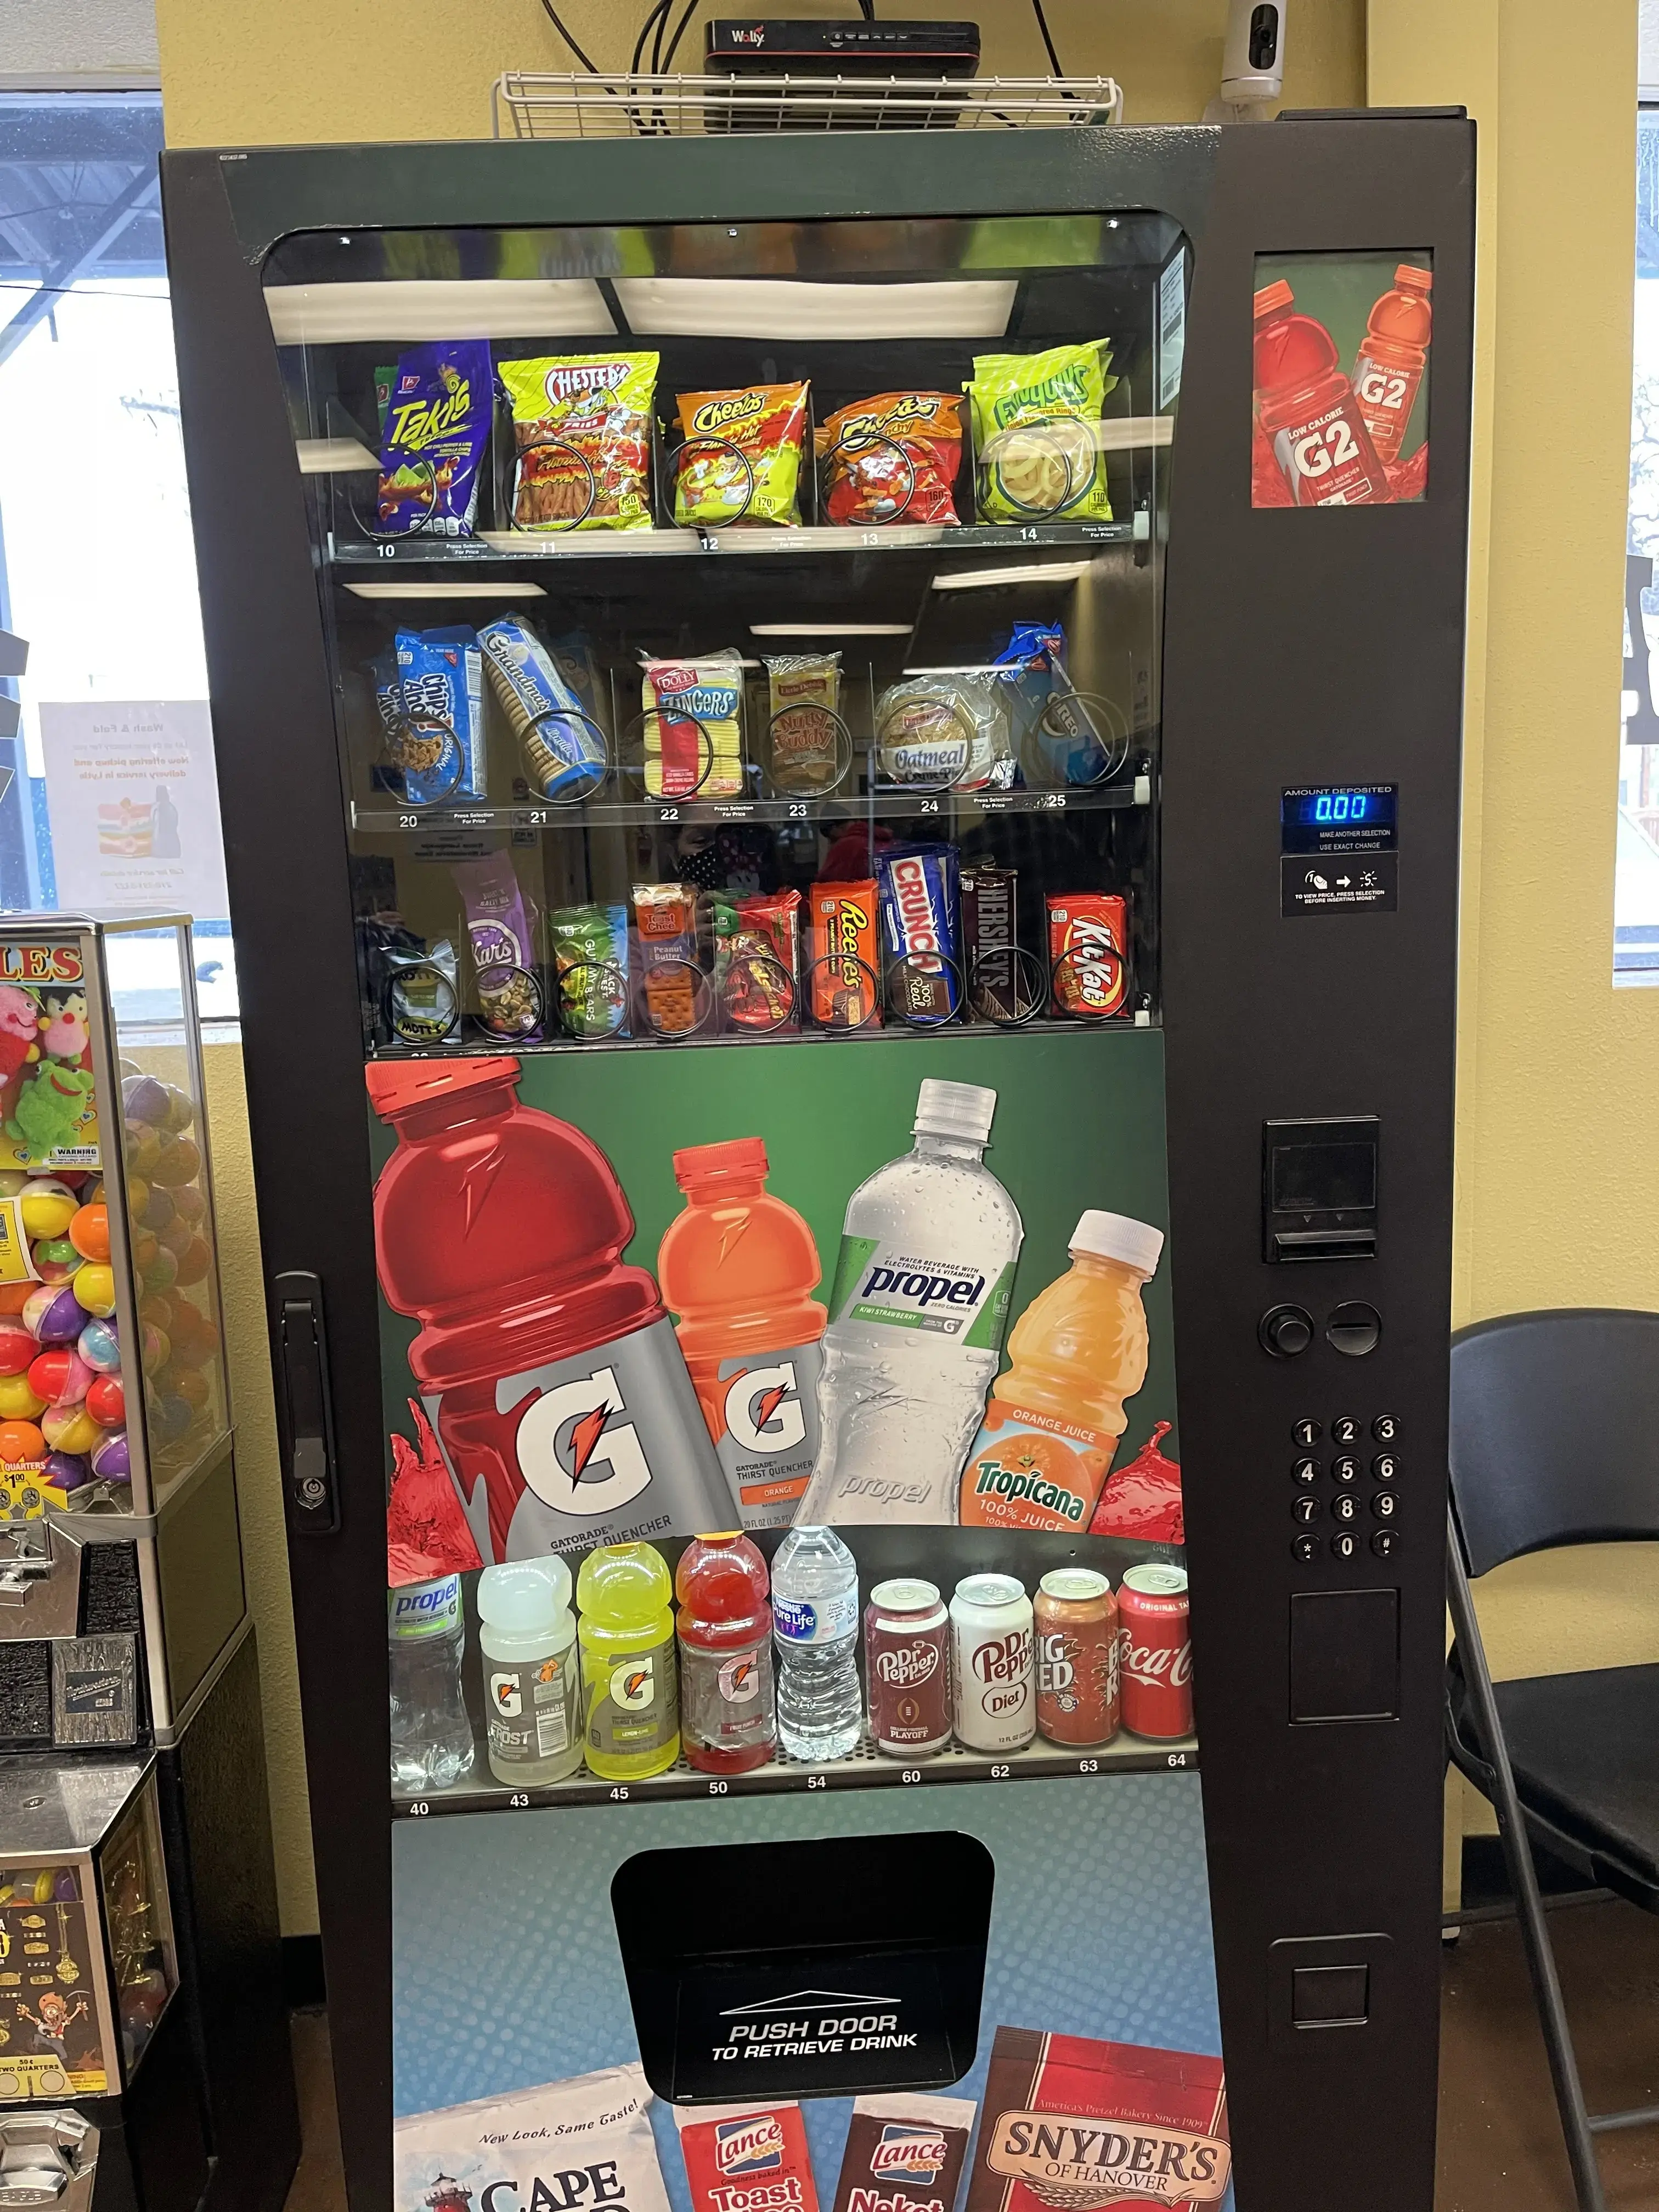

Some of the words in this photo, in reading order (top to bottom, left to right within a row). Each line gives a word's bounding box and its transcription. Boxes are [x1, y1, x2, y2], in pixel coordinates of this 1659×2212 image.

[731, 25, 765, 47] Wally
[546, 364, 630, 407] CHESTER'S
[1361, 373, 1407, 409] G2
[693, 393, 767, 433] Cheetos
[1057, 407, 1076, 415] Rings
[564, 418, 599, 430] FRIES
[1288, 425, 1307, 440] LOW
[1308, 407, 1344, 431] CALORIE
[1294, 420, 1359, 478] G2
[701, 538, 719, 550] 12
[861, 534, 878, 545] 13
[1019, 527, 1038, 540] 14
[377, 545, 395, 557] 10
[540, 541, 555, 554] 11
[662, 672, 696, 689] DOLLY
[420, 673, 449, 721] Chips
[548, 728, 572, 754] Vanilla
[895, 743, 966, 769] Oatmeal
[789, 804, 807, 817] 23
[921, 800, 939, 812] 24
[1048, 795, 1066, 808] 25
[1316, 795, 1366, 820] 0.00
[399, 815, 417, 827] 20
[530, 811, 547, 823] 21
[661, 808, 679, 820] 22
[895, 861, 939, 969] CRUNCH
[978, 889, 1009, 987] HERSHEY'S
[471, 938, 512, 967] Kar's
[653, 945, 683, 953] Peanut
[584, 986, 595, 1021] BEARS
[909, 977, 926, 1009] Real
[884, 1260, 935, 1273] ELECTROLYTES
[943, 1269, 976, 1279] VITAMINS
[899, 1256, 923, 1265] WATER
[924, 1259, 961, 1270] BEVERAGE
[961, 1265, 979, 1273] WITH
[861, 1266, 986, 1307] propel
[859, 1306, 874, 1315] KIWI
[874, 1308, 917, 1321] STRAWBERRY
[724, 1362, 806, 1454] G
[1012, 1409, 1062, 1431] ORANGE
[1062, 1423, 1097, 1443] JUICE
[1302, 1424, 1312, 1443] 1
[1342, 1422, 1353, 1440] 2
[1381, 1419, 1394, 1438] 3
[516, 1365, 653, 1516] G
[4, 1461, 46, 1472] QUARTERS
[737, 1470, 766, 1480] THIRST
[769, 1460, 814, 1477] QUENCHER
[1301, 1463, 1313, 1481] 4
[1341, 1462, 1353, 1480] 5
[1381, 1458, 1393, 1477] 6
[764, 1485, 793, 1497] ORANGE
[838, 1474, 933, 1505] propel
[975, 1459, 1086, 1522] Tropicana
[979, 1498, 1018, 1521] 100%
[1302, 1502, 1313, 1520] 7
[1341, 1499, 1353, 1518] 8
[1381, 1497, 1393, 1515] 9
[603, 1514, 673, 1546] QUENCHER
[743, 1520, 751, 1529] 20
[1341, 1537, 1353, 1555] 0
[396, 1576, 457, 1616] propel
[1140, 1602, 1178, 1612] ORIGINAL
[877, 1652, 935, 1684] Pepper
[972, 1637, 1034, 1684] Peppe
[609, 1656, 655, 1712] G
[717, 1648, 759, 1704] G
[1036, 1661, 1074, 1691] ED
[490, 1672, 522, 1718] G
[992, 1690, 1019, 1713] Diet
[489, 1723, 531, 1745] FROST
[890, 1730, 929, 1739] PLAYOFF
[1079, 1759, 1098, 1773] 63
[1167, 1753, 1186, 1767] 64
[807, 1775, 826, 1789] 54
[901, 1770, 921, 1784] 60
[990, 1765, 1009, 1778] 62
[610, 1787, 629, 1800] 45
[709, 1781, 728, 1795] 50
[410, 1802, 429, 1816] 40
[510, 1793, 529, 1807] 43
[729, 2021, 810, 2042] PUSH
[817, 2015, 898, 2035] DOOR
[712, 2046, 740, 2061] TO
[744, 2038, 843, 2059] RETRIEVE
[849, 2033, 918, 2051] DRINK
[1036, 2098, 1084, 2113] America's
[1086, 2103, 1119, 2117] Pretzel
[1120, 2107, 1152, 2120] Bakery
[1154, 2111, 1181, 2125] Since
[478, 2132, 510, 2145] New
[512, 2126, 551, 2141] Look,
[554, 2119, 595, 2136] Same
[716, 2121, 782, 2170] Lance
[871, 2139, 948, 2172] Lance
[1005, 2121, 1218, 2182] SNYDER'S
[480, 2160, 626, 2212] CAPE
[1045, 2162, 1070, 2178] OF
[1075, 2167, 1168, 2192] HANOVER
[709, 2176, 802, 2211] Toast
[851, 2187, 944, 2212] Nekot
